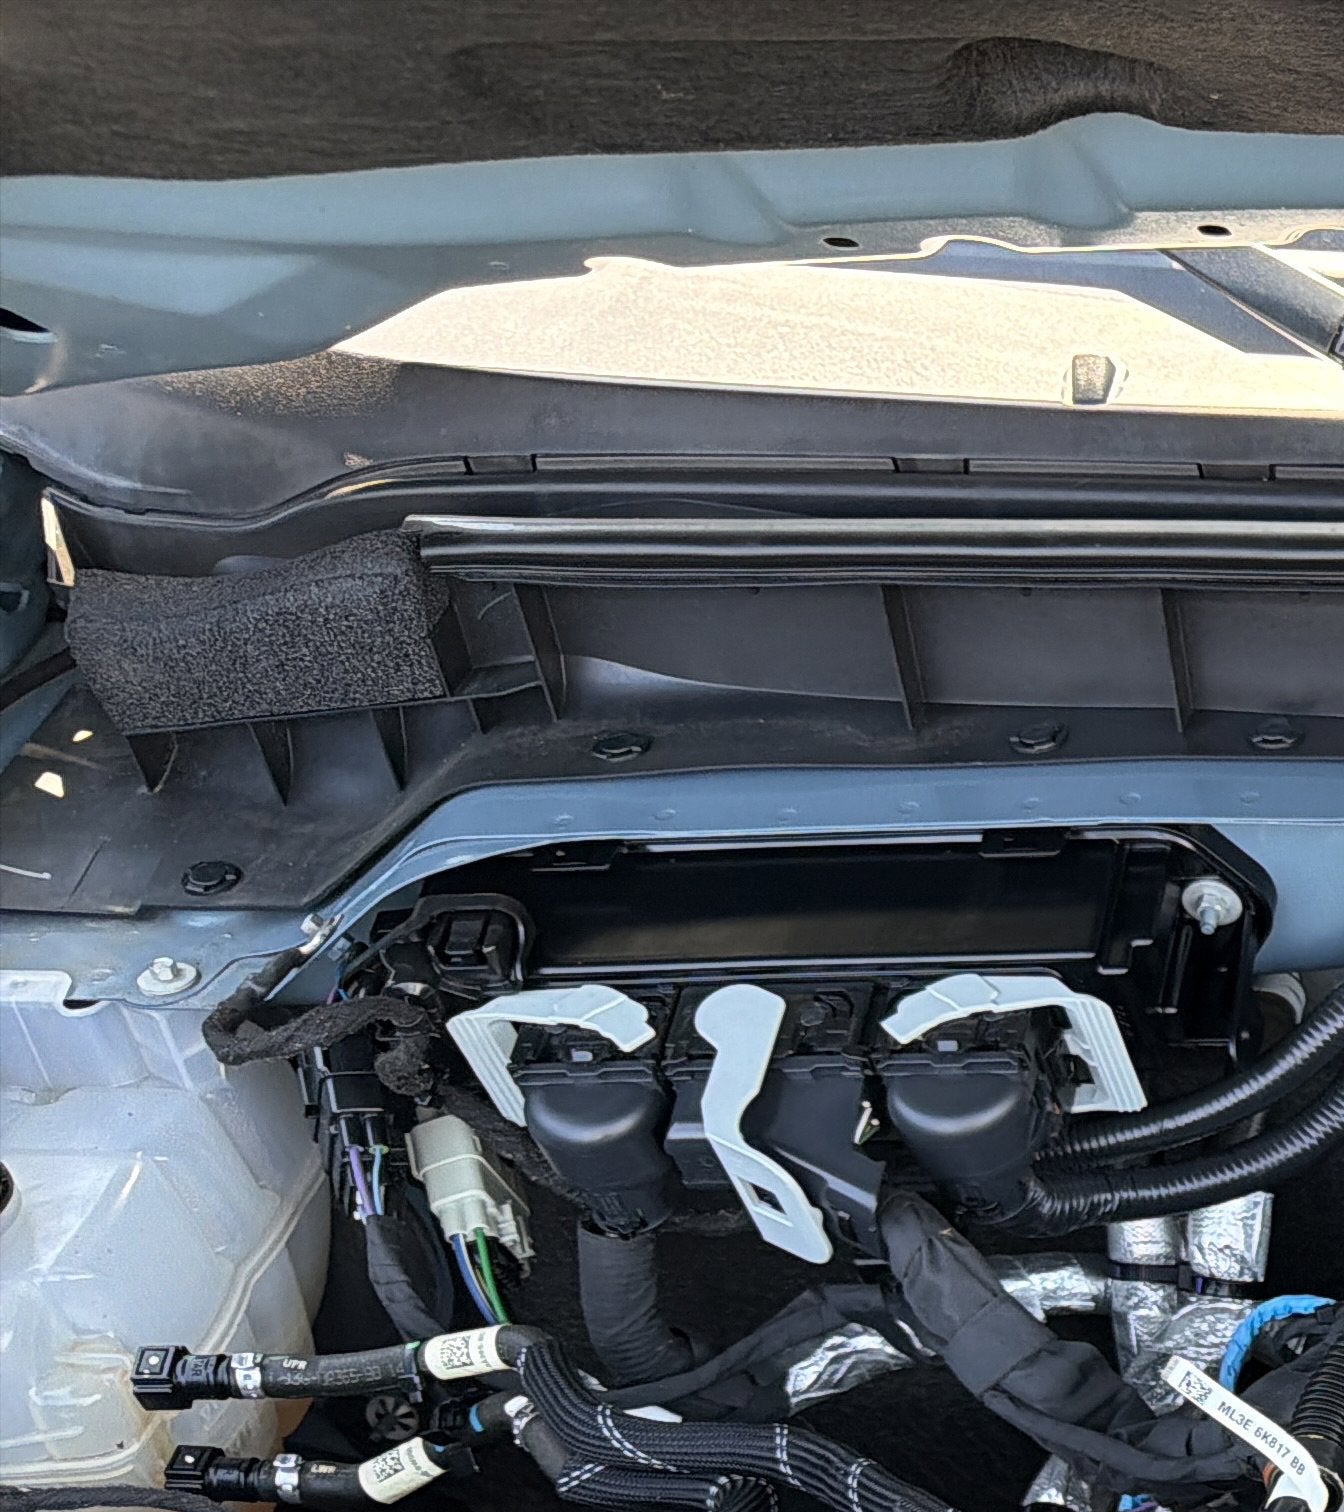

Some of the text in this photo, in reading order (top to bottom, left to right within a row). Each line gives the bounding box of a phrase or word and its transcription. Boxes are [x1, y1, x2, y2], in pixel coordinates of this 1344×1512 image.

[281, 1356, 309, 1372] UPR
[1216, 1400, 1308, 1477] ML3E 6K817 BB
